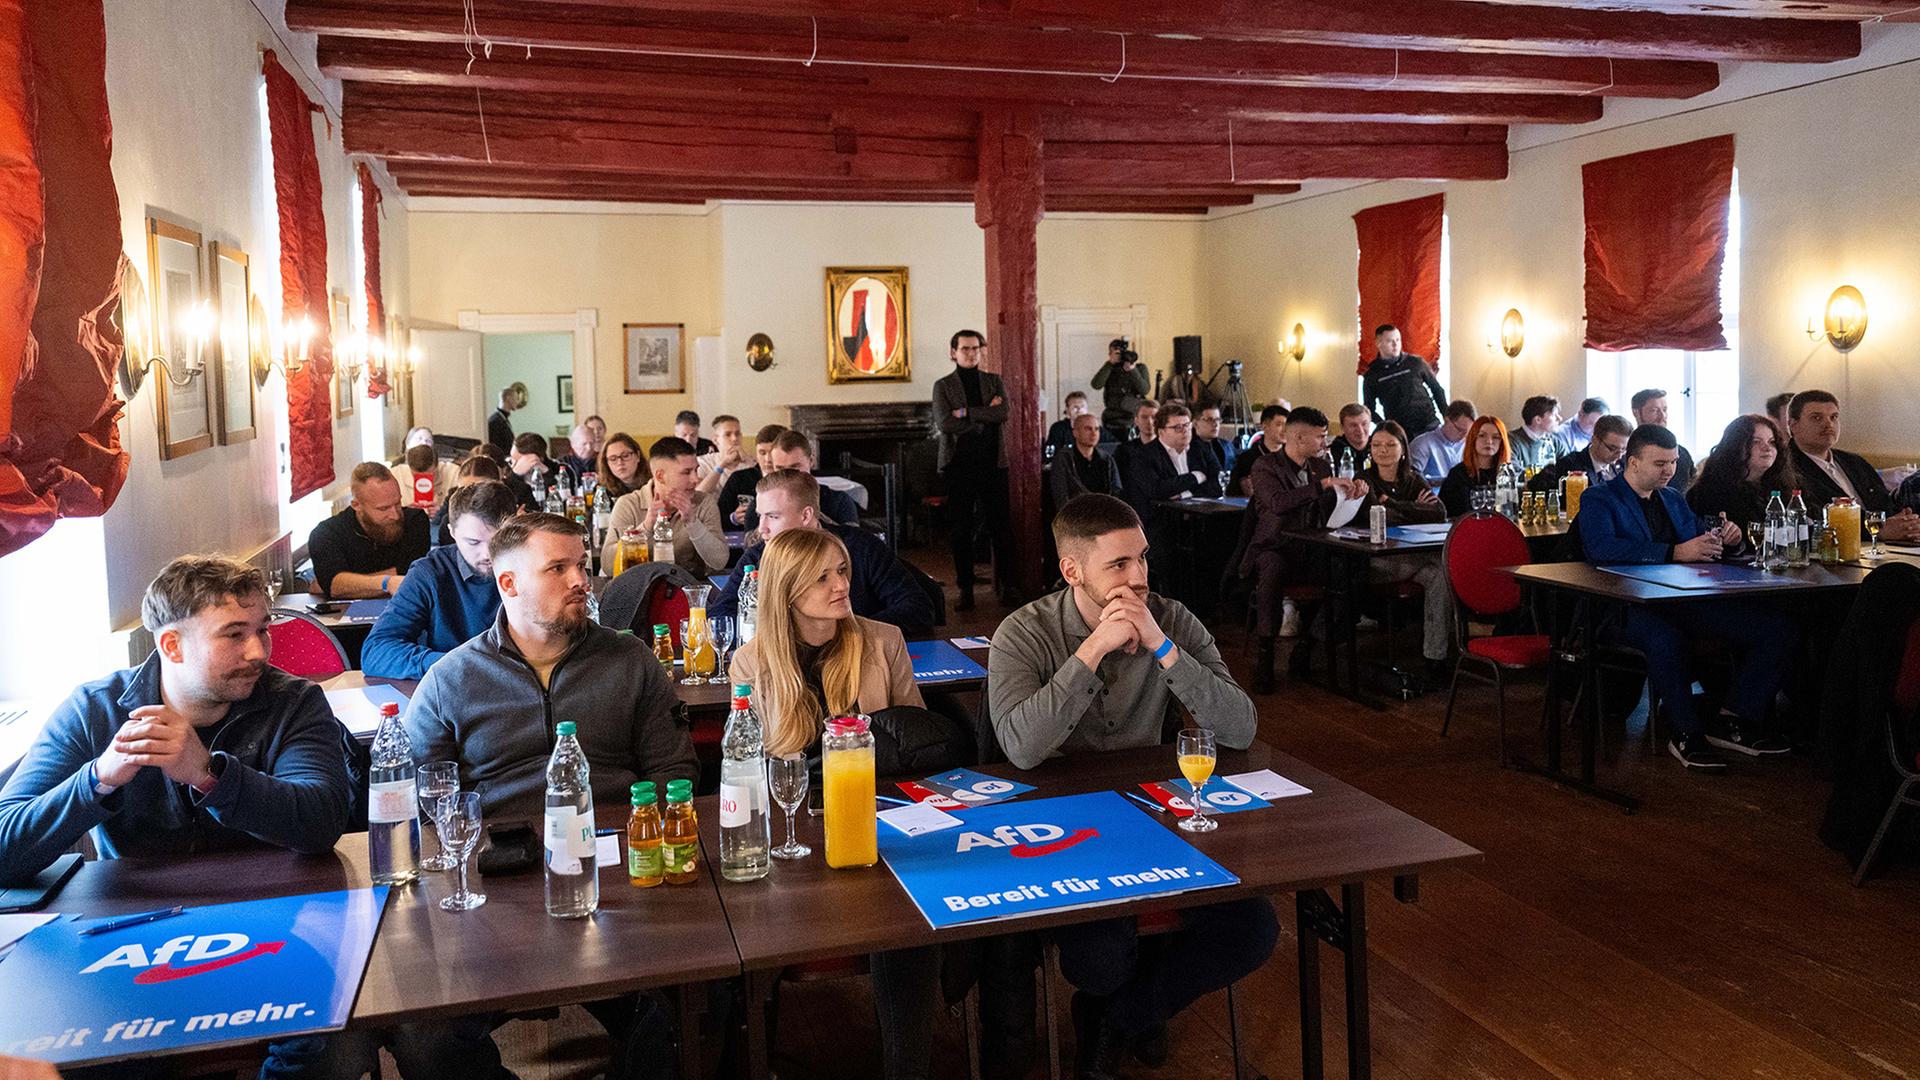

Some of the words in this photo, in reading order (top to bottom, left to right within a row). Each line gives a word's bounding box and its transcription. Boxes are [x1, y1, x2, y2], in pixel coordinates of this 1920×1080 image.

[956, 822, 1065, 853] AfD
[943, 885, 1050, 912] Bereit
[1051, 878, 1101, 896] für
[1107, 865, 1205, 888] mehr.
[79, 932, 250, 975] AfD
[103, 1017, 177, 1044] für
[184, 1002, 316, 1033] mehr.
